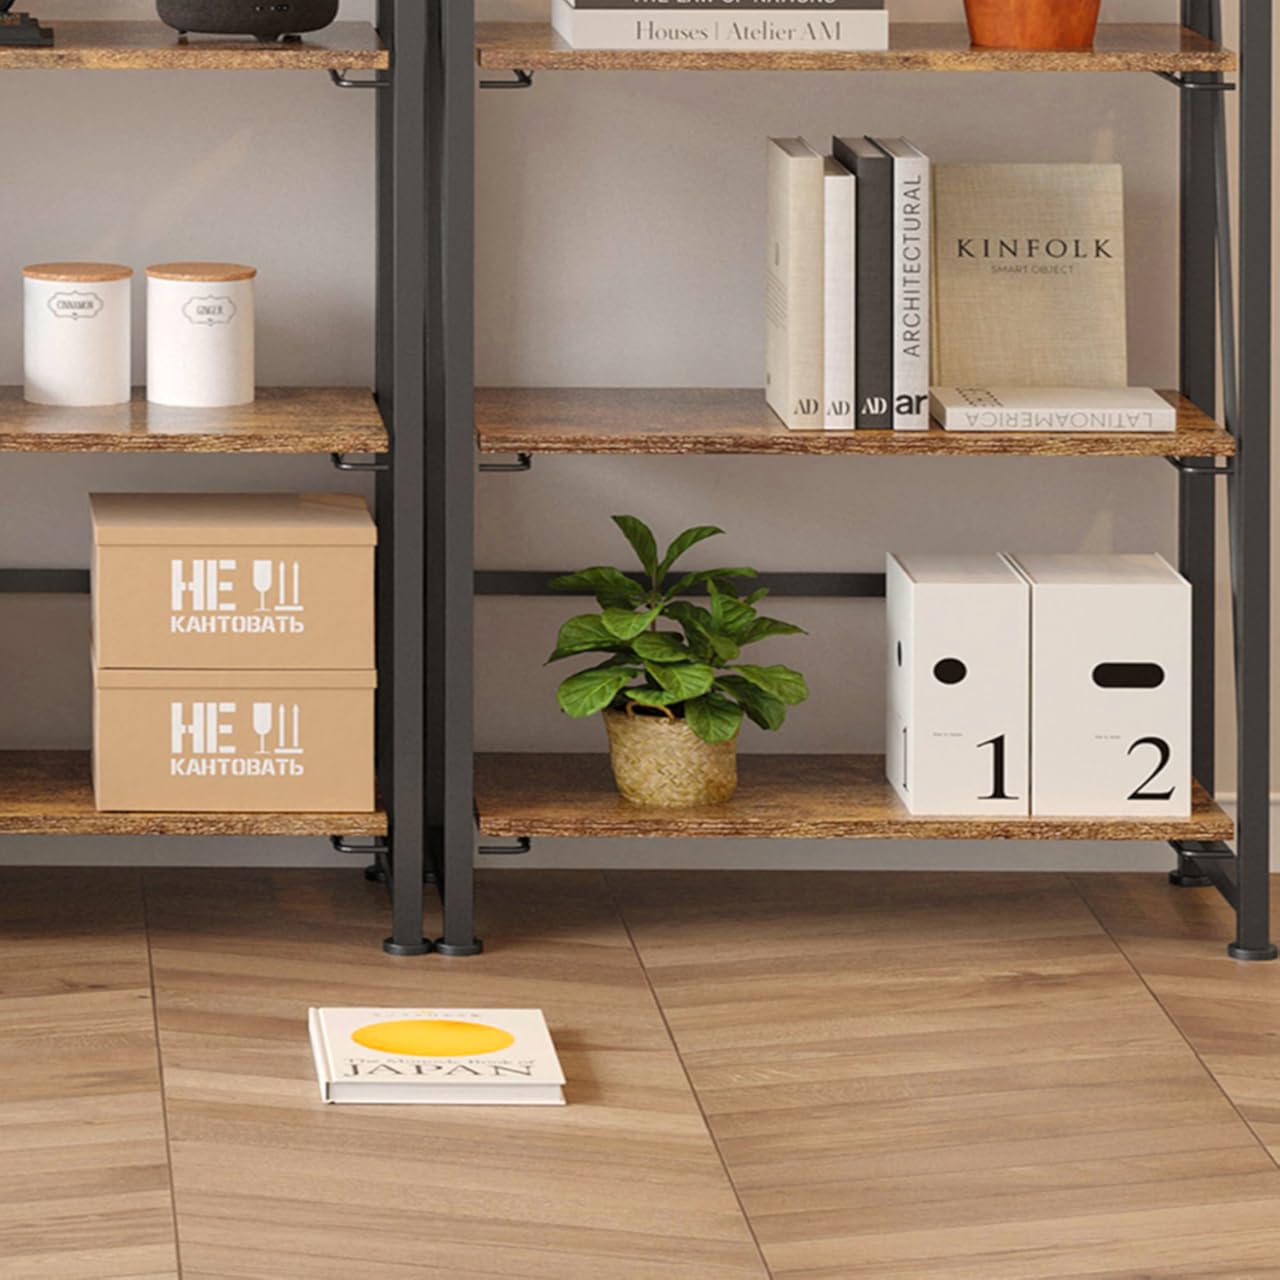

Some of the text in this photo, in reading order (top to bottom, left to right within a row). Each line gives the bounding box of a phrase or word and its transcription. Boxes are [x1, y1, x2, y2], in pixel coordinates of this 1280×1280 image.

[636, 20, 841, 41] Houses Atelier AM
[956, 238, 1113, 259] KINFOLK
[902, 174, 922, 358] ARCHITECTURAL
[991, 265, 1073, 274] SMART OBJECT
[56, 299, 95, 310] CINNAMON
[196, 305, 224, 317] GINGER
[793, 398, 820, 416] AD
[826, 400, 851, 416] AD
[861, 396, 888, 416] AD
[895, 394, 929, 416] ar
[964, 412, 1153, 429] LATINOAMERICA
[171, 559, 237, 611] НЕ
[171, 615, 304, 633] КАНТОВАТЬ
[171, 702, 237, 754] НЕ
[171, 757, 304, 776] КАНТОВАТЬ
[976, 734, 1020, 800] 1
[1126, 736, 1176, 801] 2
[343, 1064, 534, 1078] JAPAN
